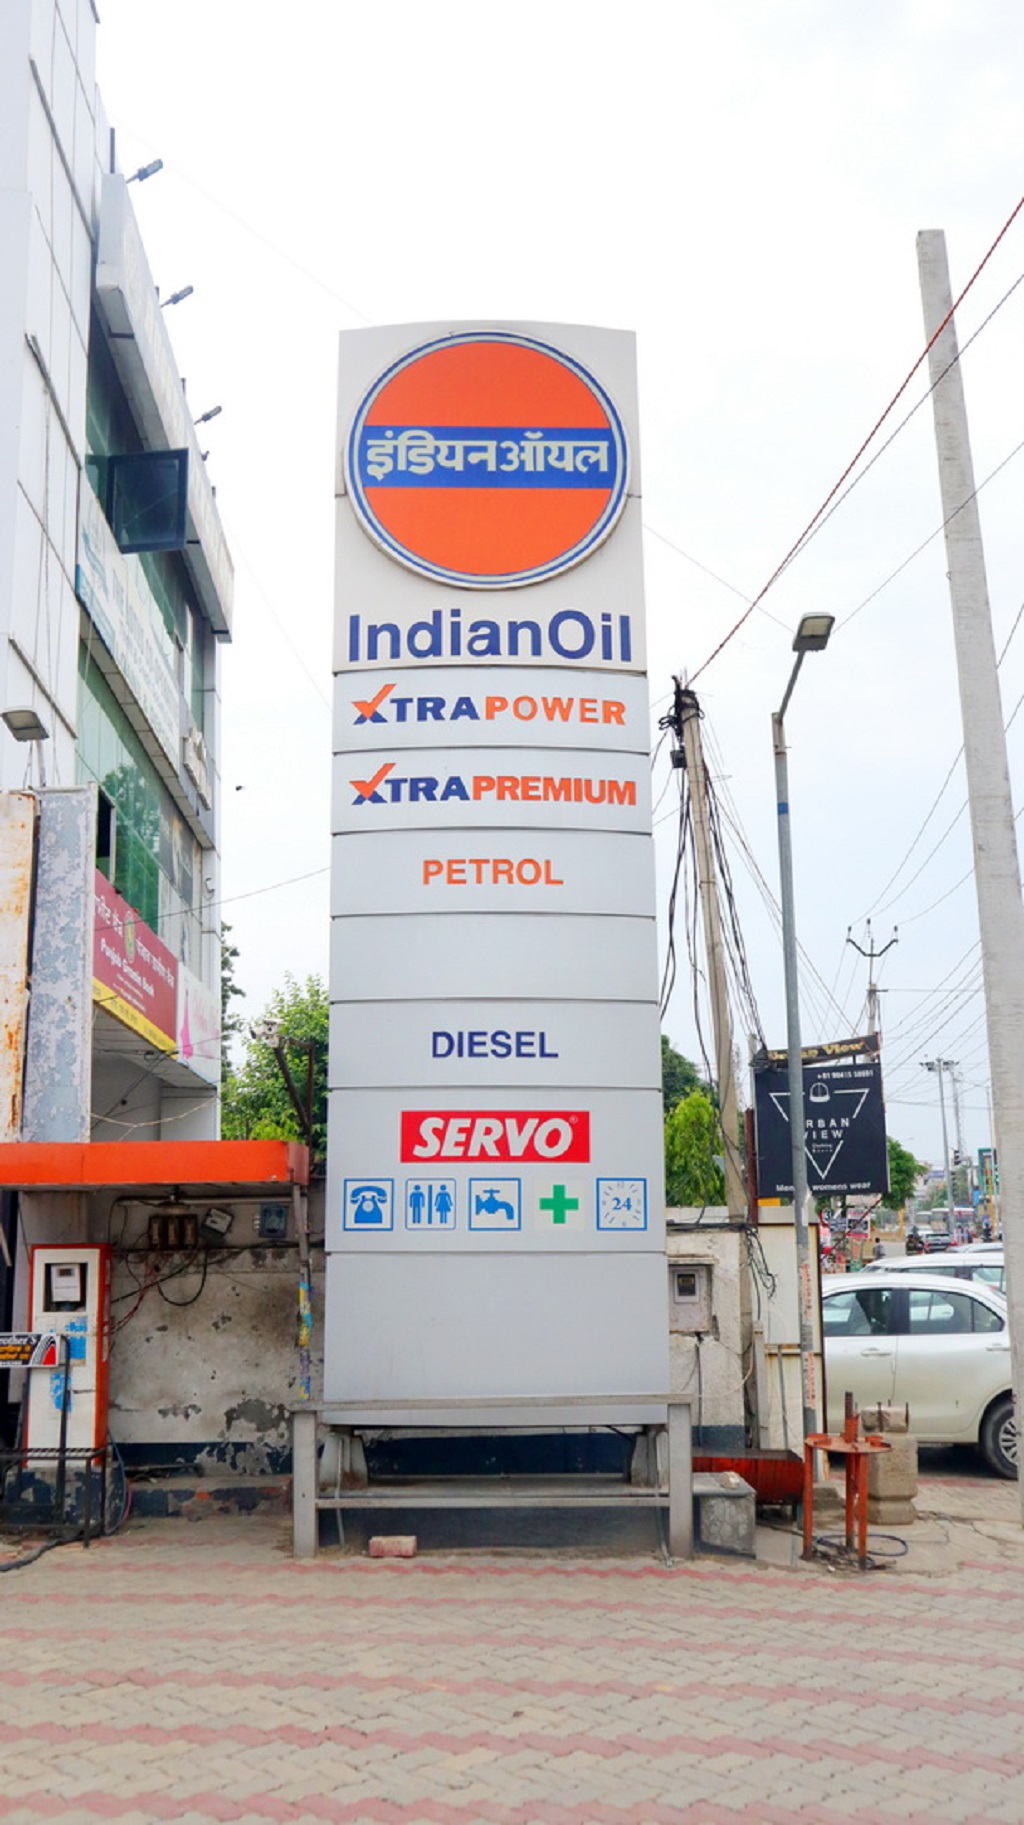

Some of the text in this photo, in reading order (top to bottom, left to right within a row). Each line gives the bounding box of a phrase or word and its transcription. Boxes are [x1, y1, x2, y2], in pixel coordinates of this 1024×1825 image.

[366, 430, 609, 481] इंडियनऑयल
[349, 608, 632, 662] IndianOil
[422, 858, 564, 885] PETROL
[432, 1030, 559, 1059] DIESEL
[412, 1116, 573, 1158] SERVO
[805, 1117, 850, 1128] RBAN
[612, 1196, 632, 1211] 24
